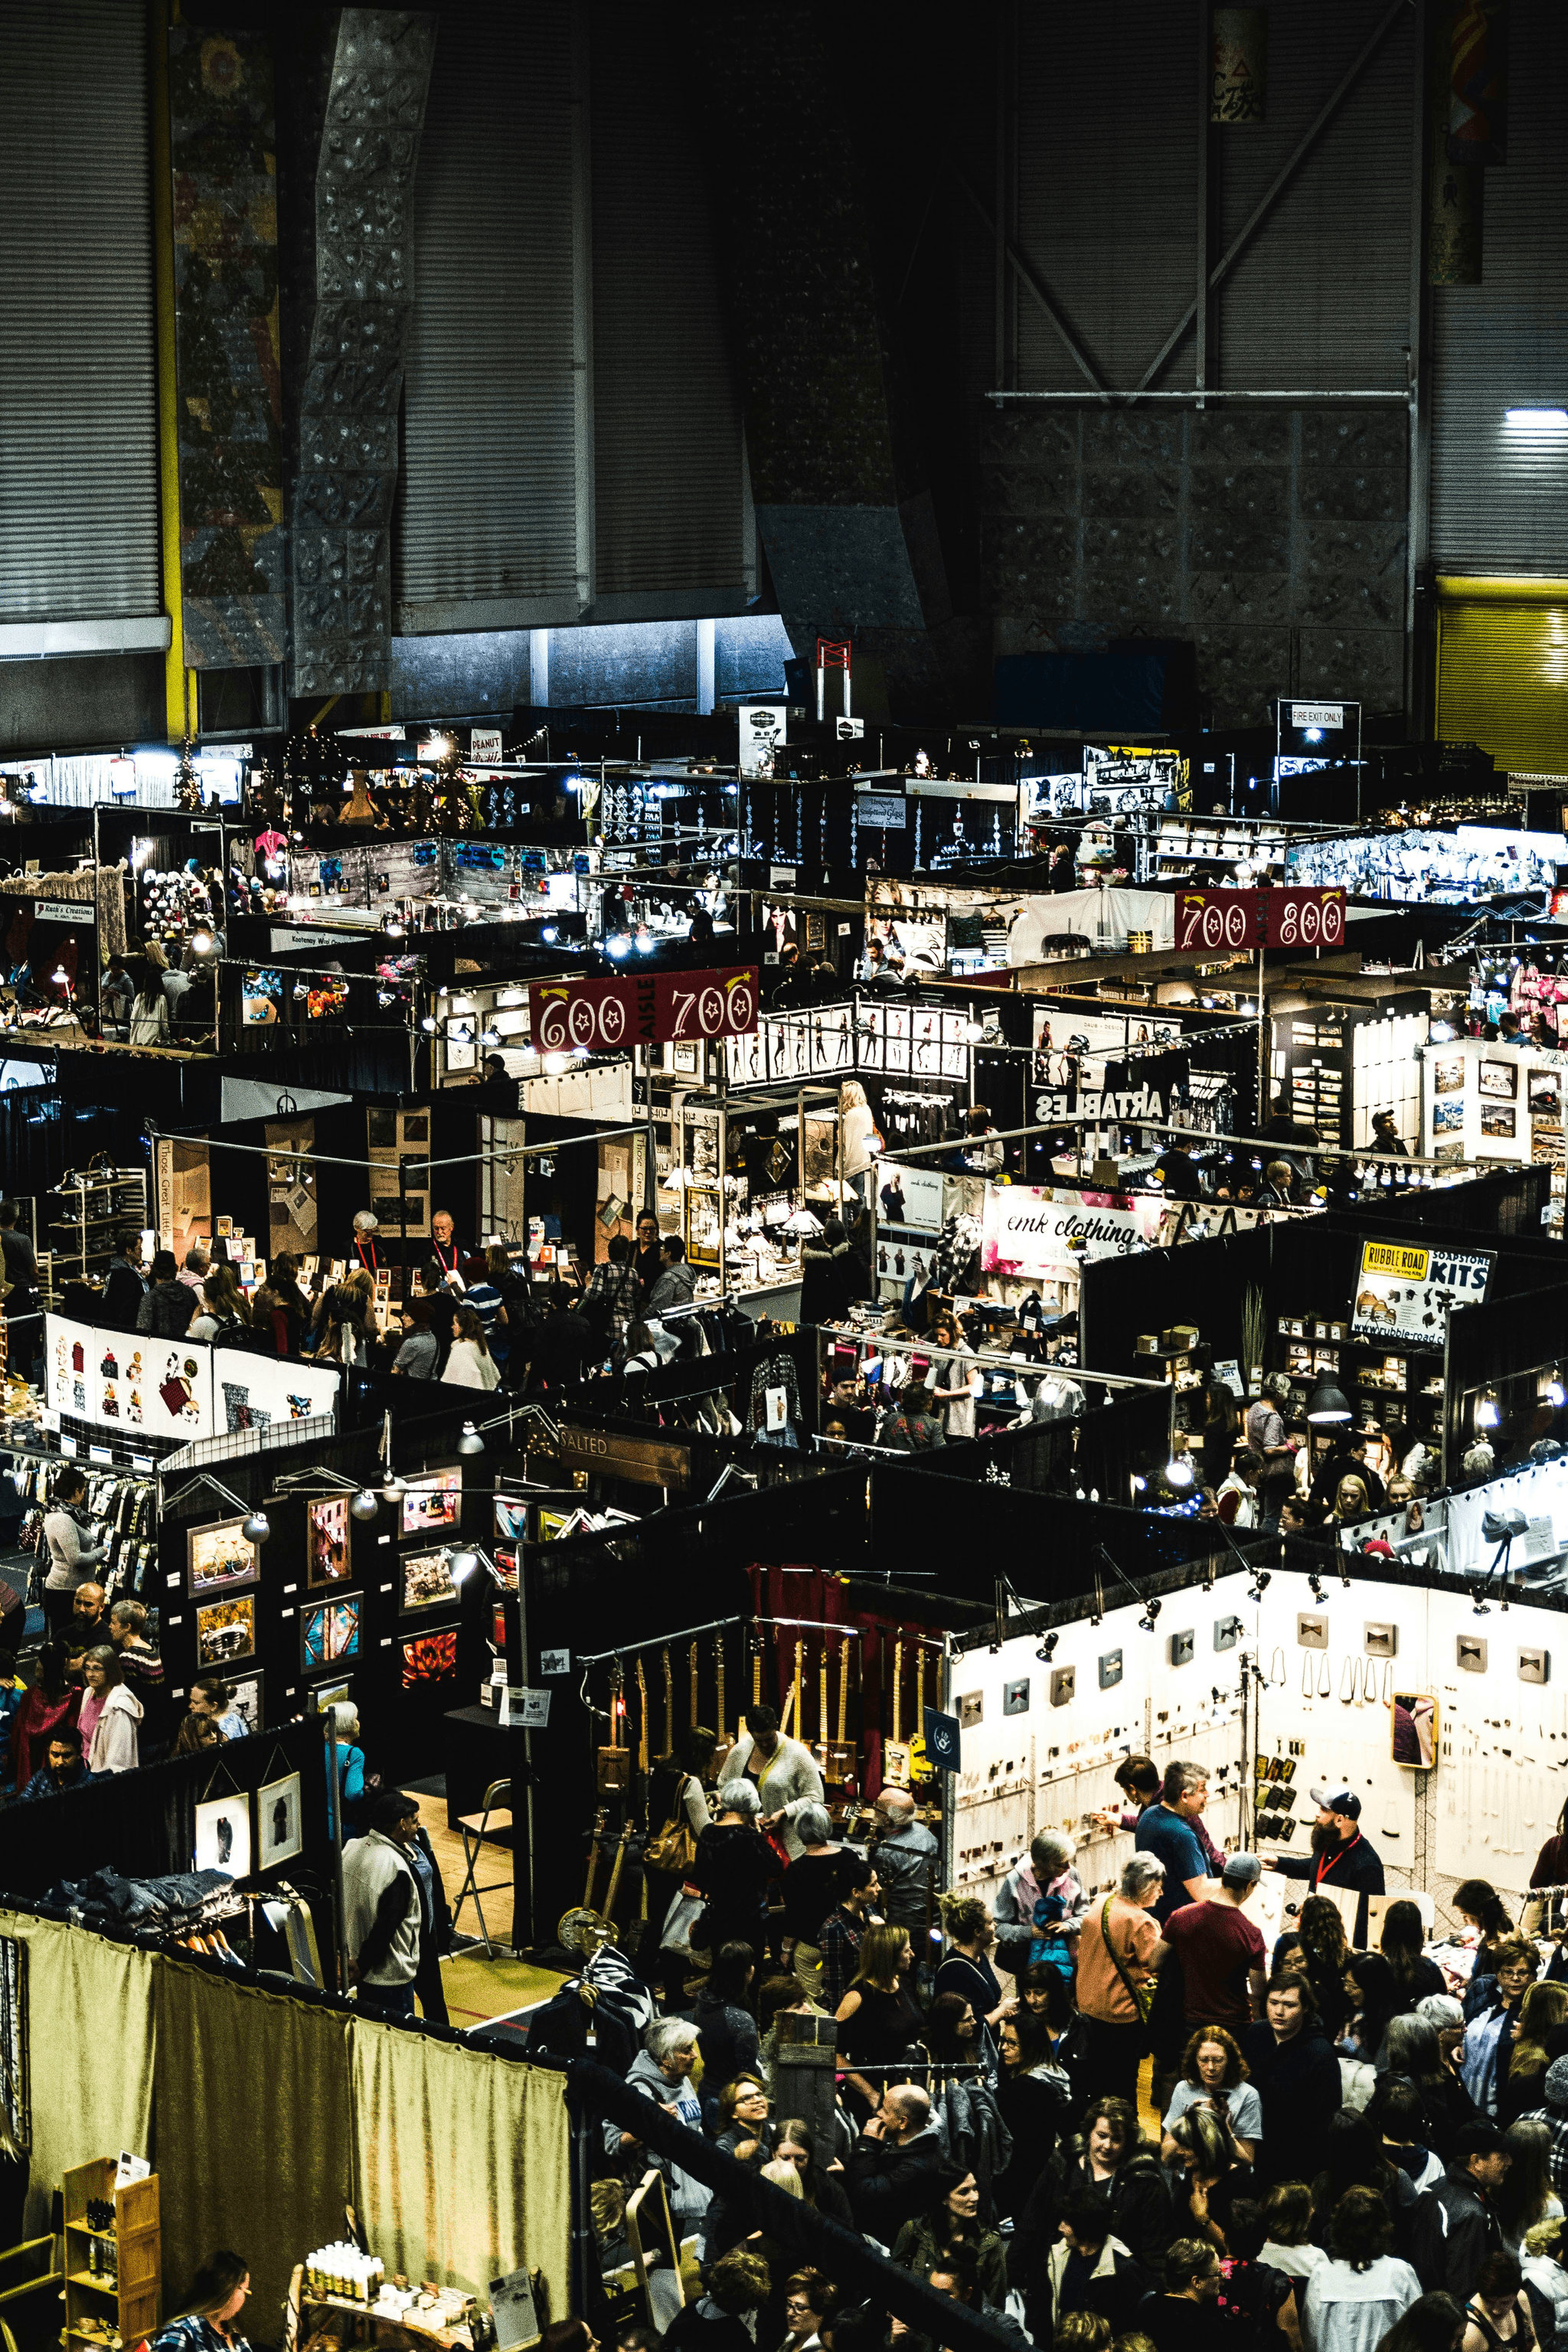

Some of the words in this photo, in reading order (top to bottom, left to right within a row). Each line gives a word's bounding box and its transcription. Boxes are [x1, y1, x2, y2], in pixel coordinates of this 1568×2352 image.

[1293, 711, 1307, 720] FIRE
[1308, 712, 1322, 721] EXIT
[1324, 713, 1341, 722] ONLY
[472, 737, 499, 750] PEANUT
[1508, 777, 1545, 786] Pinewood
[887, 808, 904, 820] Glass
[66, 906, 93, 916] Creations
[1181, 905, 1246, 949] 700
[1256, 892, 1269, 944] AISLE
[1280, 901, 1341, 945] 800
[292, 936, 315, 946] Kootenay
[541, 996, 626, 1050] 600
[637, 978, 656, 1039] AISLE
[671, 985, 752, 1038] 700
[161, 1144, 170, 1174] Those
[161, 1180, 170, 1206] Great
[162, 1213, 170, 1237] Little
[1008, 1213, 1049, 1233] emk
[1054, 1214, 1136, 1253] clothing
[1369, 1246, 1400, 1267] RUBBLE
[1402, 1251, 1424, 1270] ROAD
[1432, 1251, 1489, 1266] SOAPSTONE
[1367, 1264, 1393, 1272] Soapstone
[1393, 1267, 1411, 1276] Carving
[1429, 1260, 1488, 1289] KITS
[560, 1432, 607, 1454] SALTED
